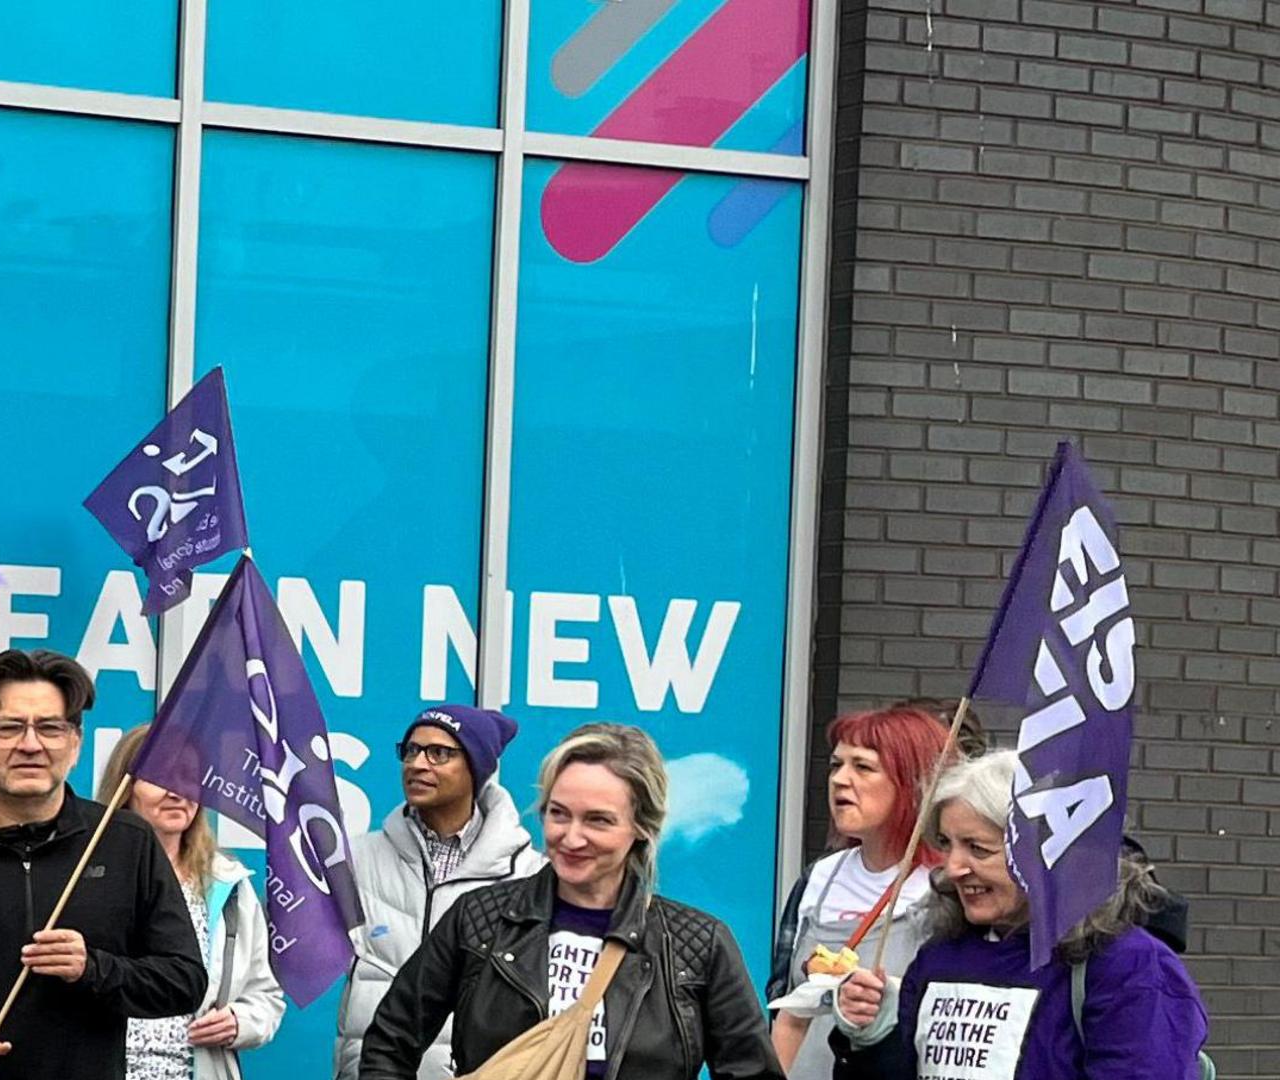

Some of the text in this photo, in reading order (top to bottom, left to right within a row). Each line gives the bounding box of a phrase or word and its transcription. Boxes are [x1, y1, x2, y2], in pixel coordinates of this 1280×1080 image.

[420, 584, 741, 713] NEW
[931, 997, 1011, 1021] FIGHTING
[927, 1021, 997, 1044] FOR THE
[925, 1045, 989, 1068] FUTURE
